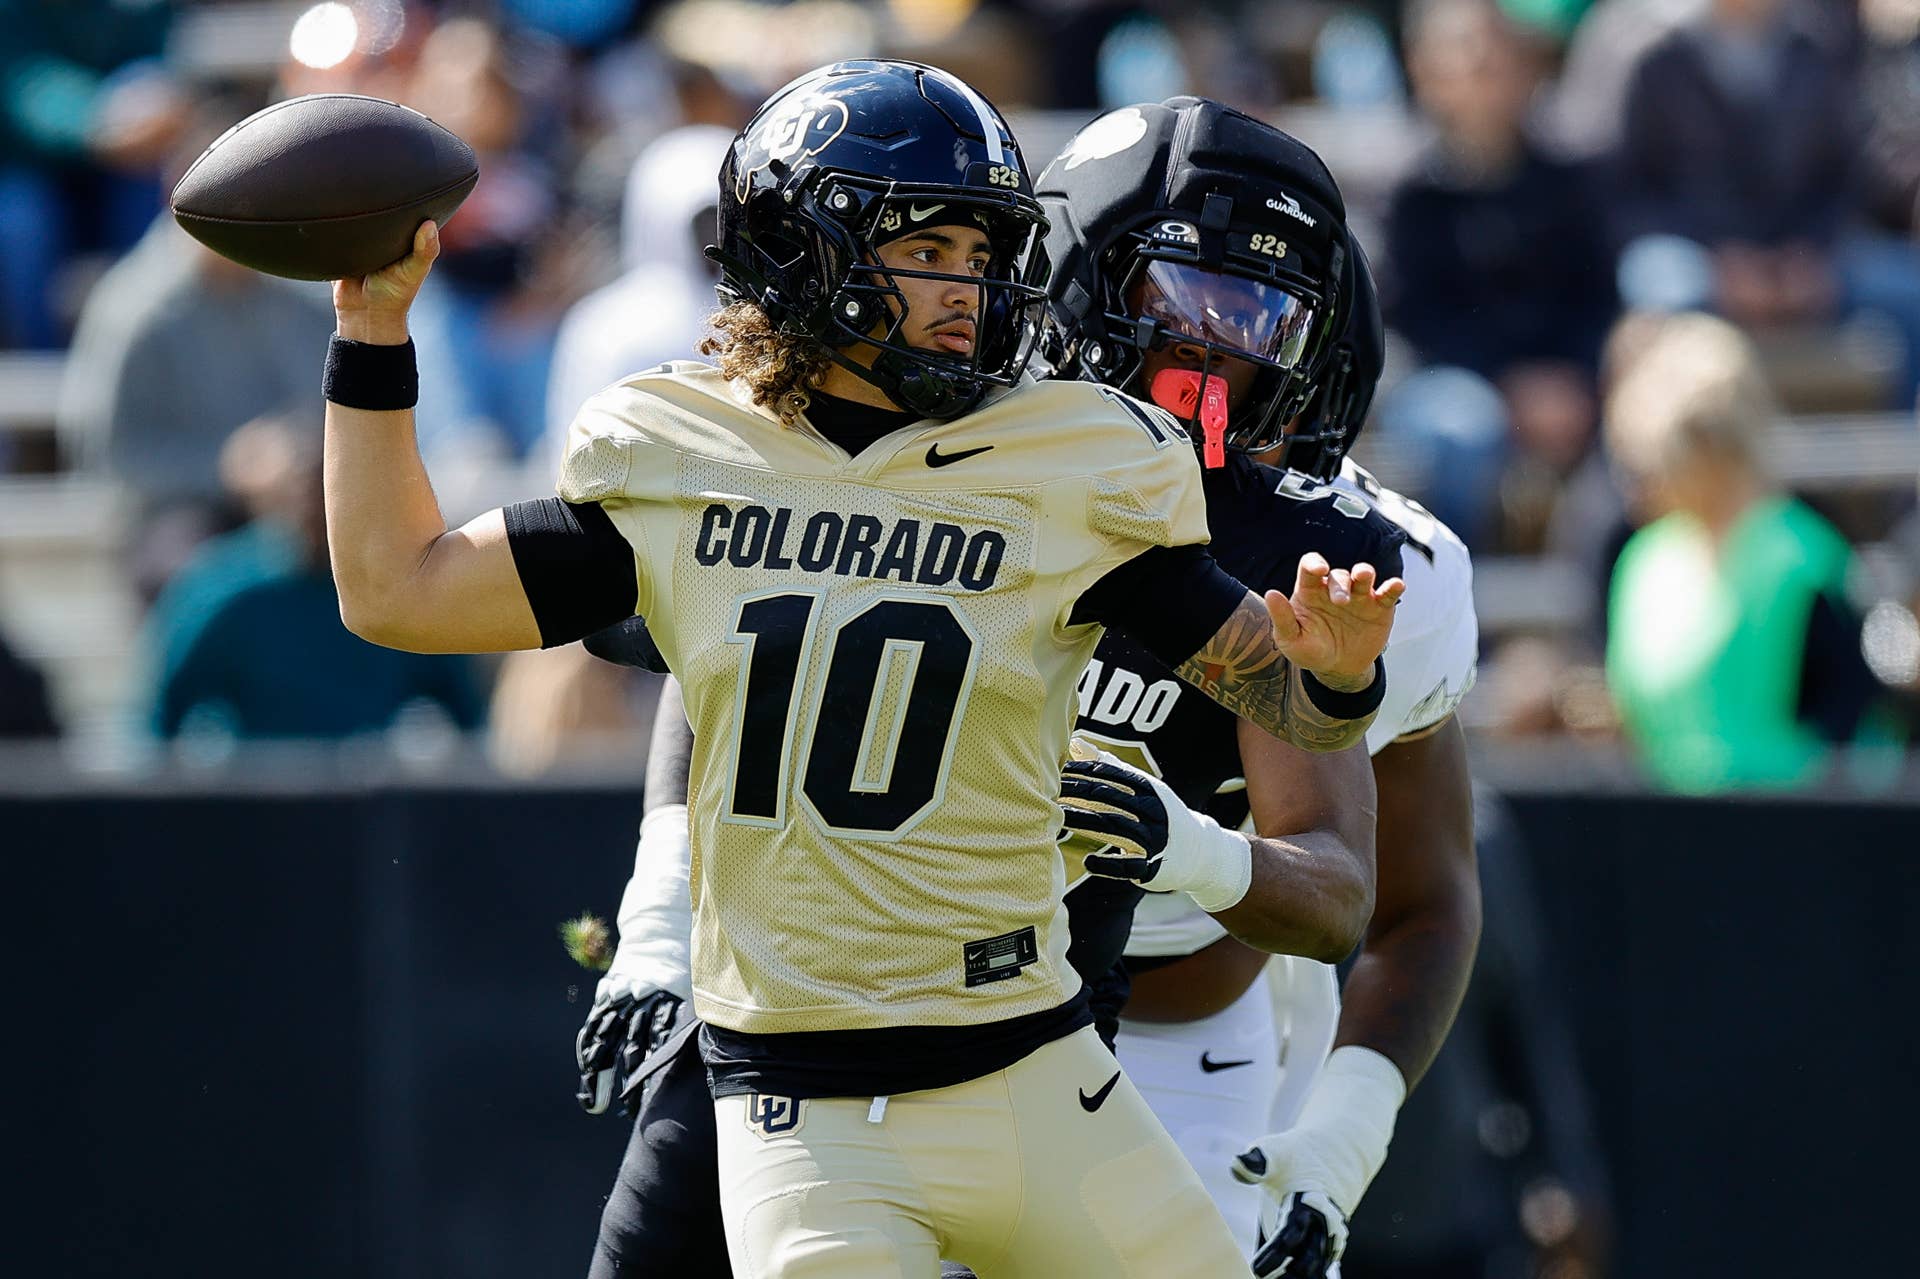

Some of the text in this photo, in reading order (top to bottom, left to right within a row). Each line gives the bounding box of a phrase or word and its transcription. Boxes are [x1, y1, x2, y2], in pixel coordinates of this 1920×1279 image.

[988, 165, 1020, 189] S2S
[1265, 198, 1314, 228] GUARDIAN
[1250, 233, 1287, 258] S2S
[694, 503, 1007, 592] COLORADO
[722, 585, 984, 843] 10
